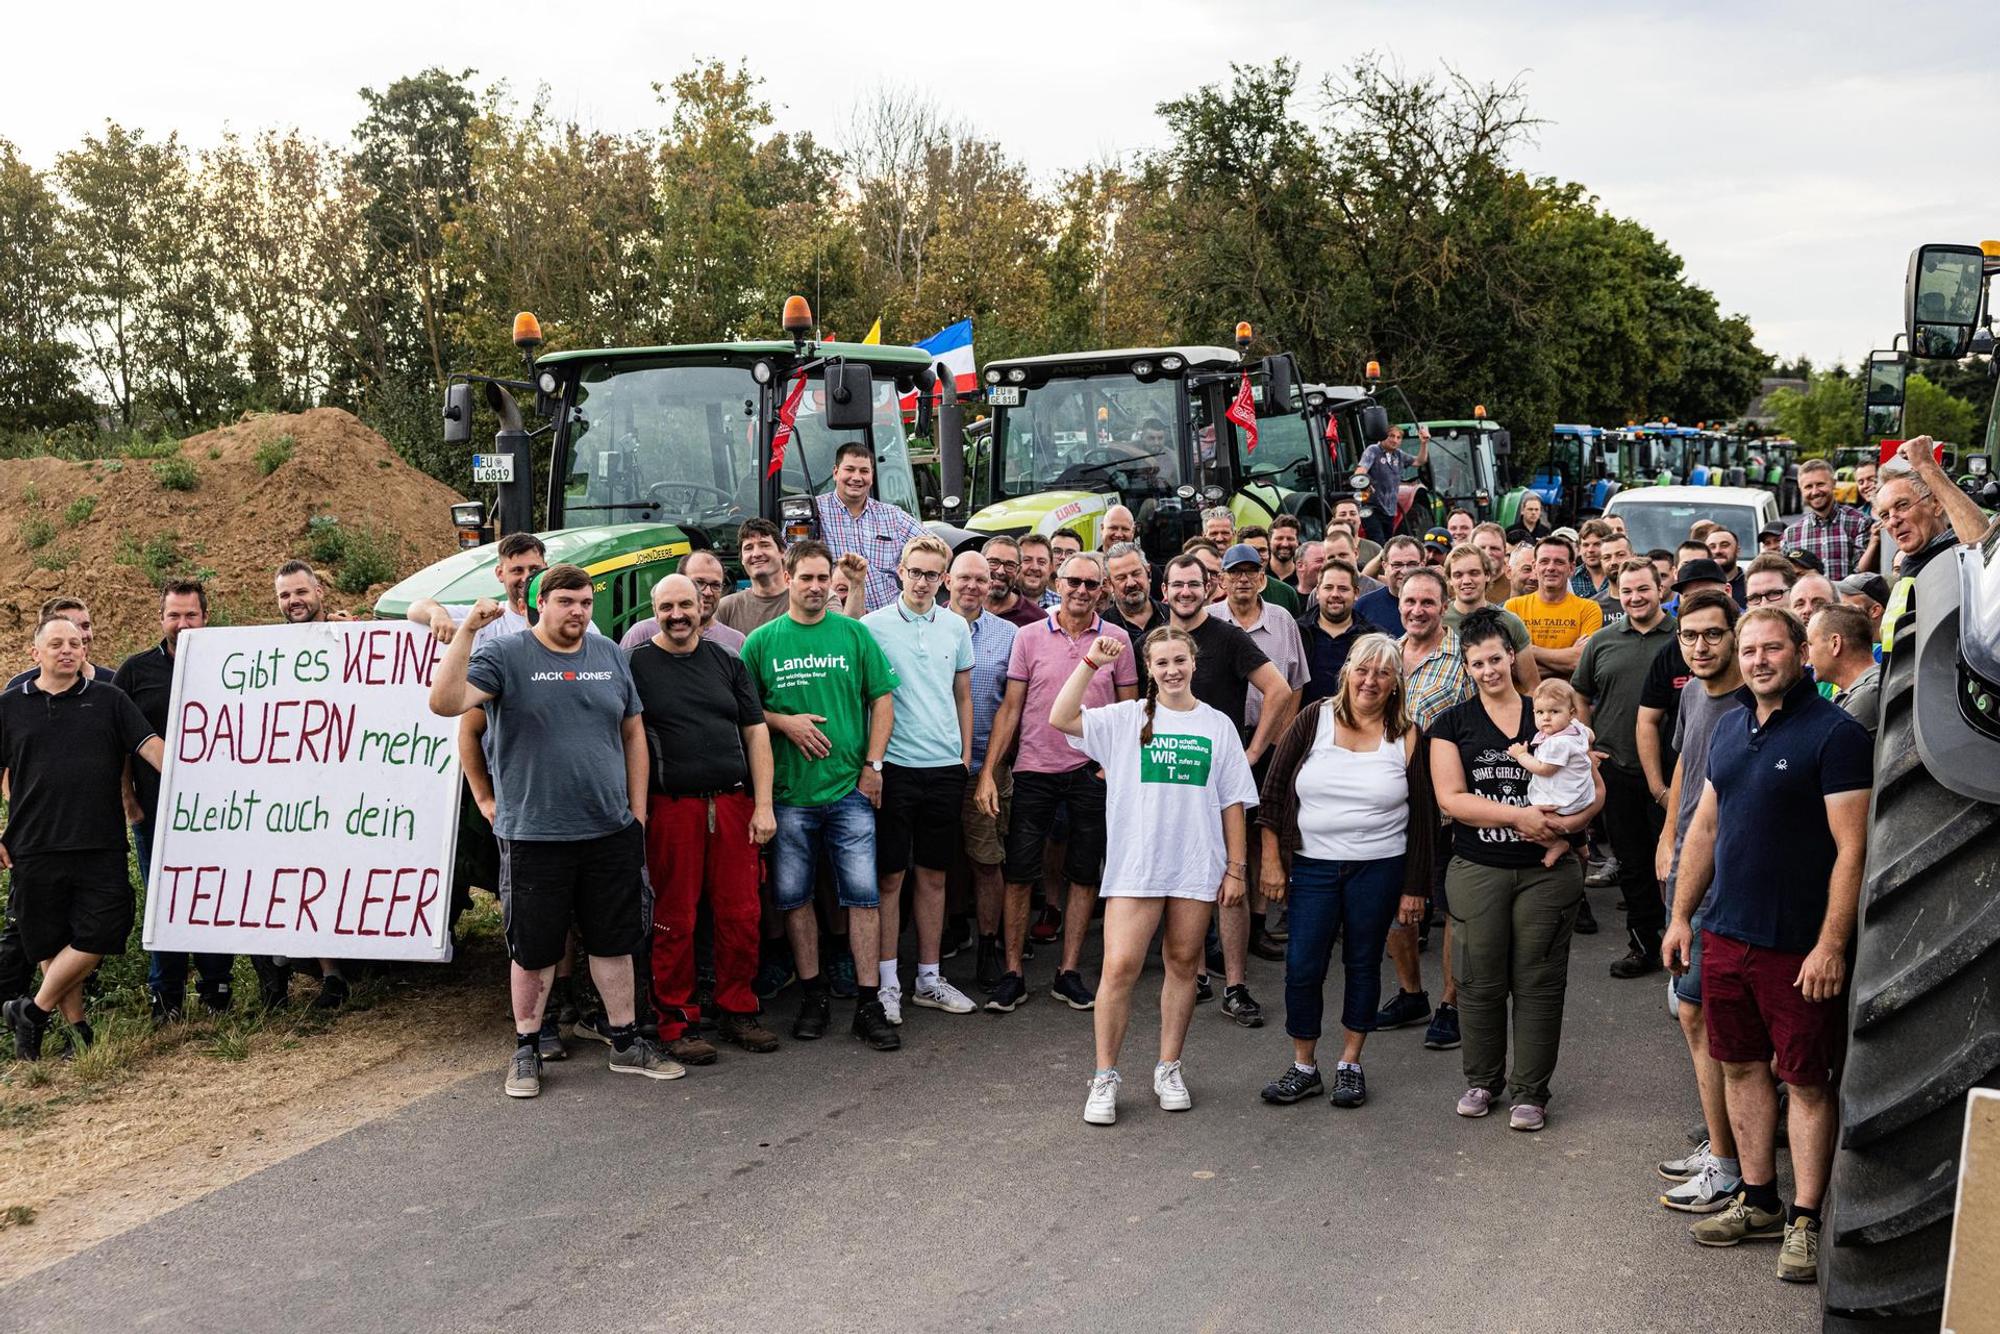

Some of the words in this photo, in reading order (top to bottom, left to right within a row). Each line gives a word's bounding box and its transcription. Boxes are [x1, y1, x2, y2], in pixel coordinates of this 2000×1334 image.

[480, 457, 493, 468] EU
[477, 469, 484, 481] L
[485, 469, 510, 480] 6819
[1544, 618, 1577, 627] TAILOR
[772, 653, 849, 673] Landwirt,
[221, 648, 285, 695] Gibt
[294, 650, 330, 682] es
[530, 671, 564, 682] JACK
[178, 700, 356, 764] BAUERN
[359, 722, 452, 774] mehr,
[1150, 750, 1177, 764] WIR
[1167, 766, 1176, 780] T
[1472, 767, 1494, 782] SOME
[1495, 766, 1521, 780] GIRLS
[172, 789, 262, 832] bleibt
[266, 795, 329, 833] auch
[345, 792, 415, 840] dein
[163, 865, 327, 933] TELLER
[334, 868, 440, 937] LEER
